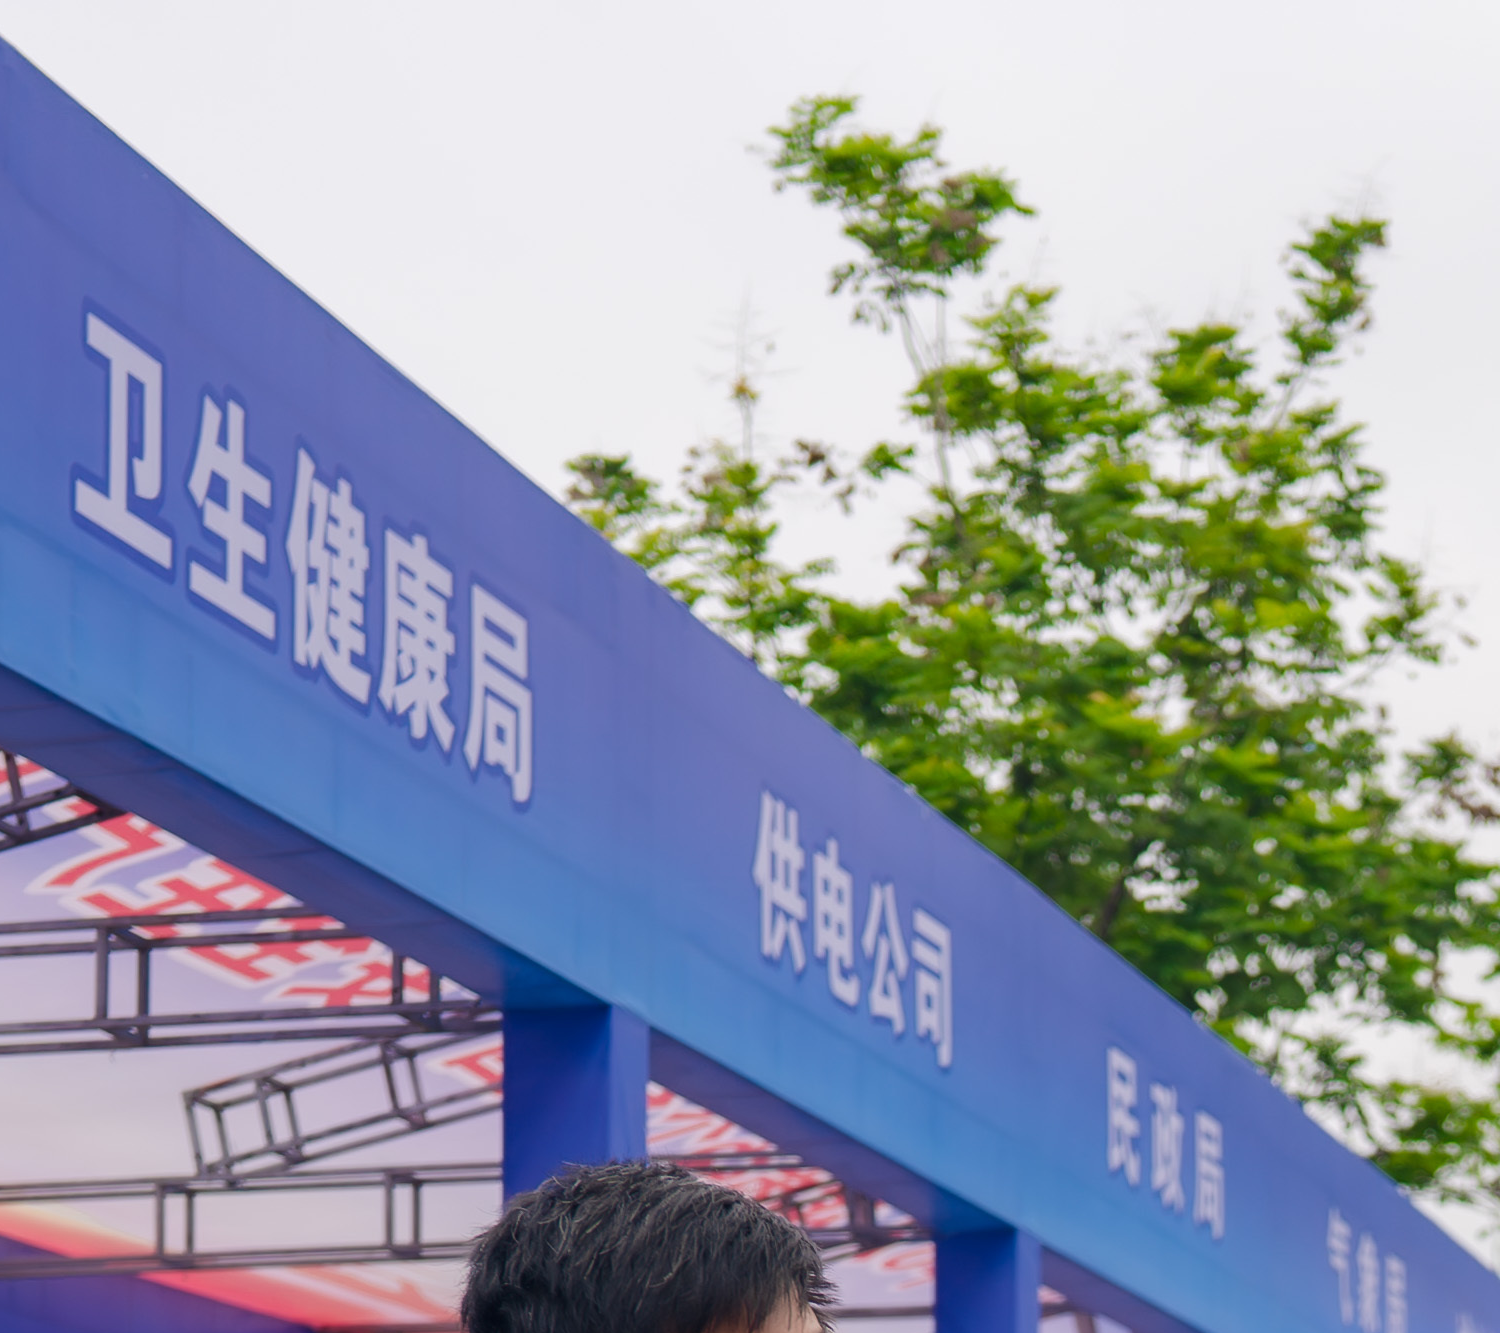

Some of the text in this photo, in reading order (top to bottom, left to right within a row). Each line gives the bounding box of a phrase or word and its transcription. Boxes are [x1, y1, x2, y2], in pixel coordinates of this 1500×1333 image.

[73, 311, 533, 805] 卫生健康局
[753, 790, 953, 1070] 供电公司
[1107, 1046, 1225, 1241] 民政局
